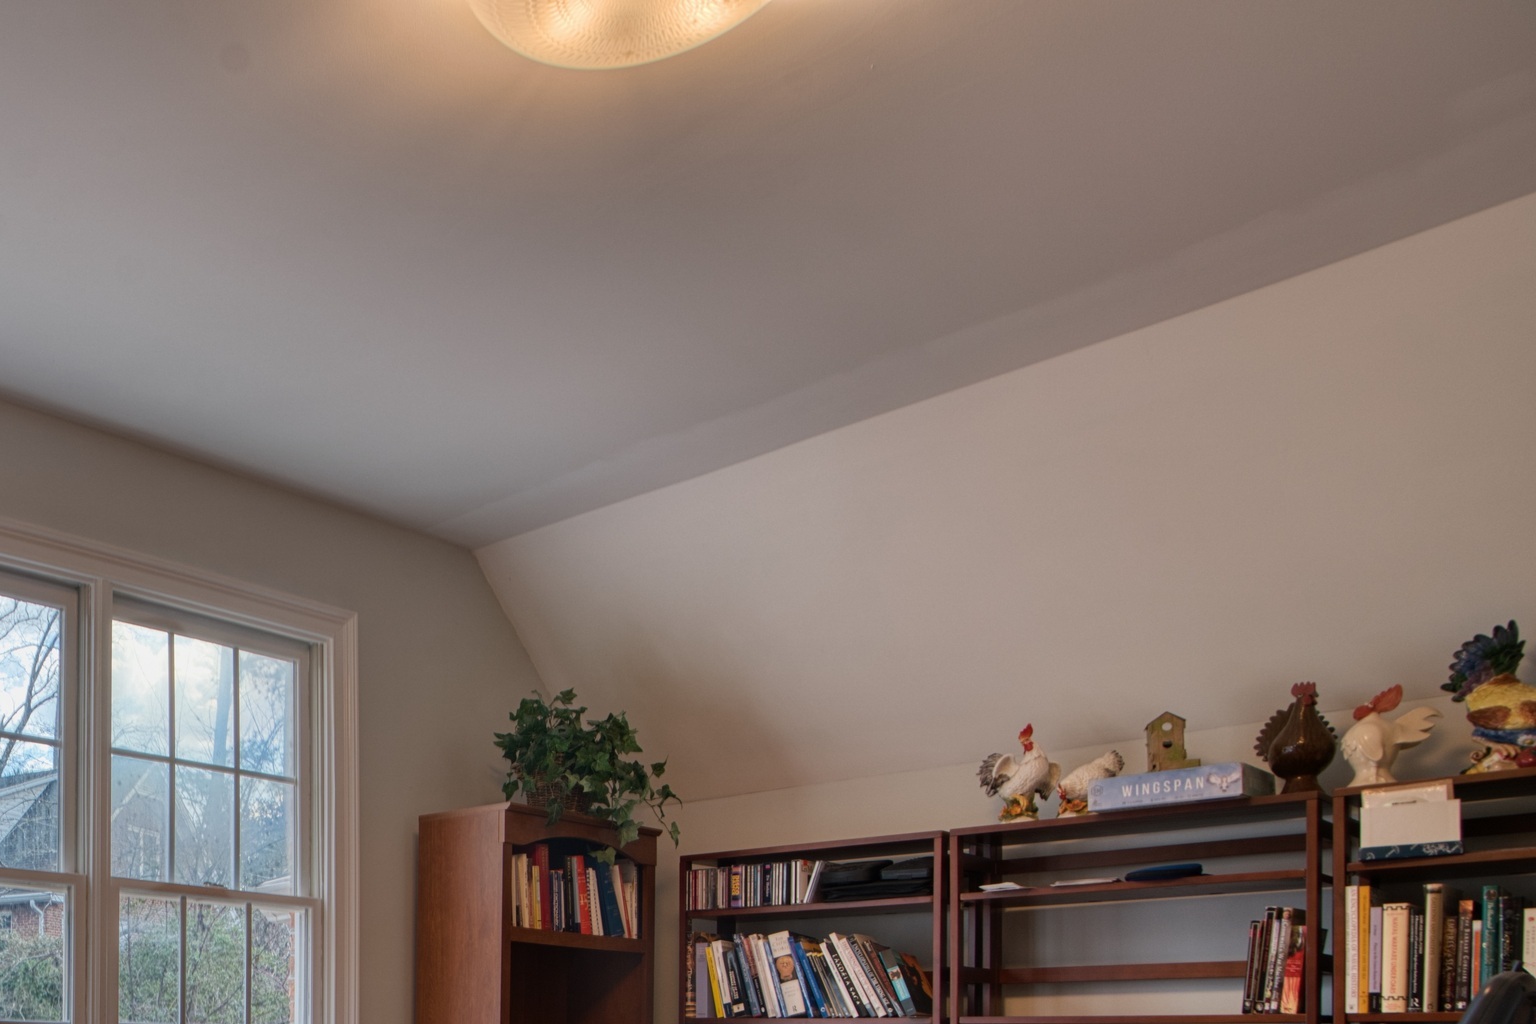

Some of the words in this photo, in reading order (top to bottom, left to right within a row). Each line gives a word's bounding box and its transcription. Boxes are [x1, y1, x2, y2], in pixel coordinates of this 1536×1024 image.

[1121, 776, 1205, 797] WINGSPAN
[1445, 918, 1455, 947] EMPIRES
[1444, 957, 1453, 970] SEA
